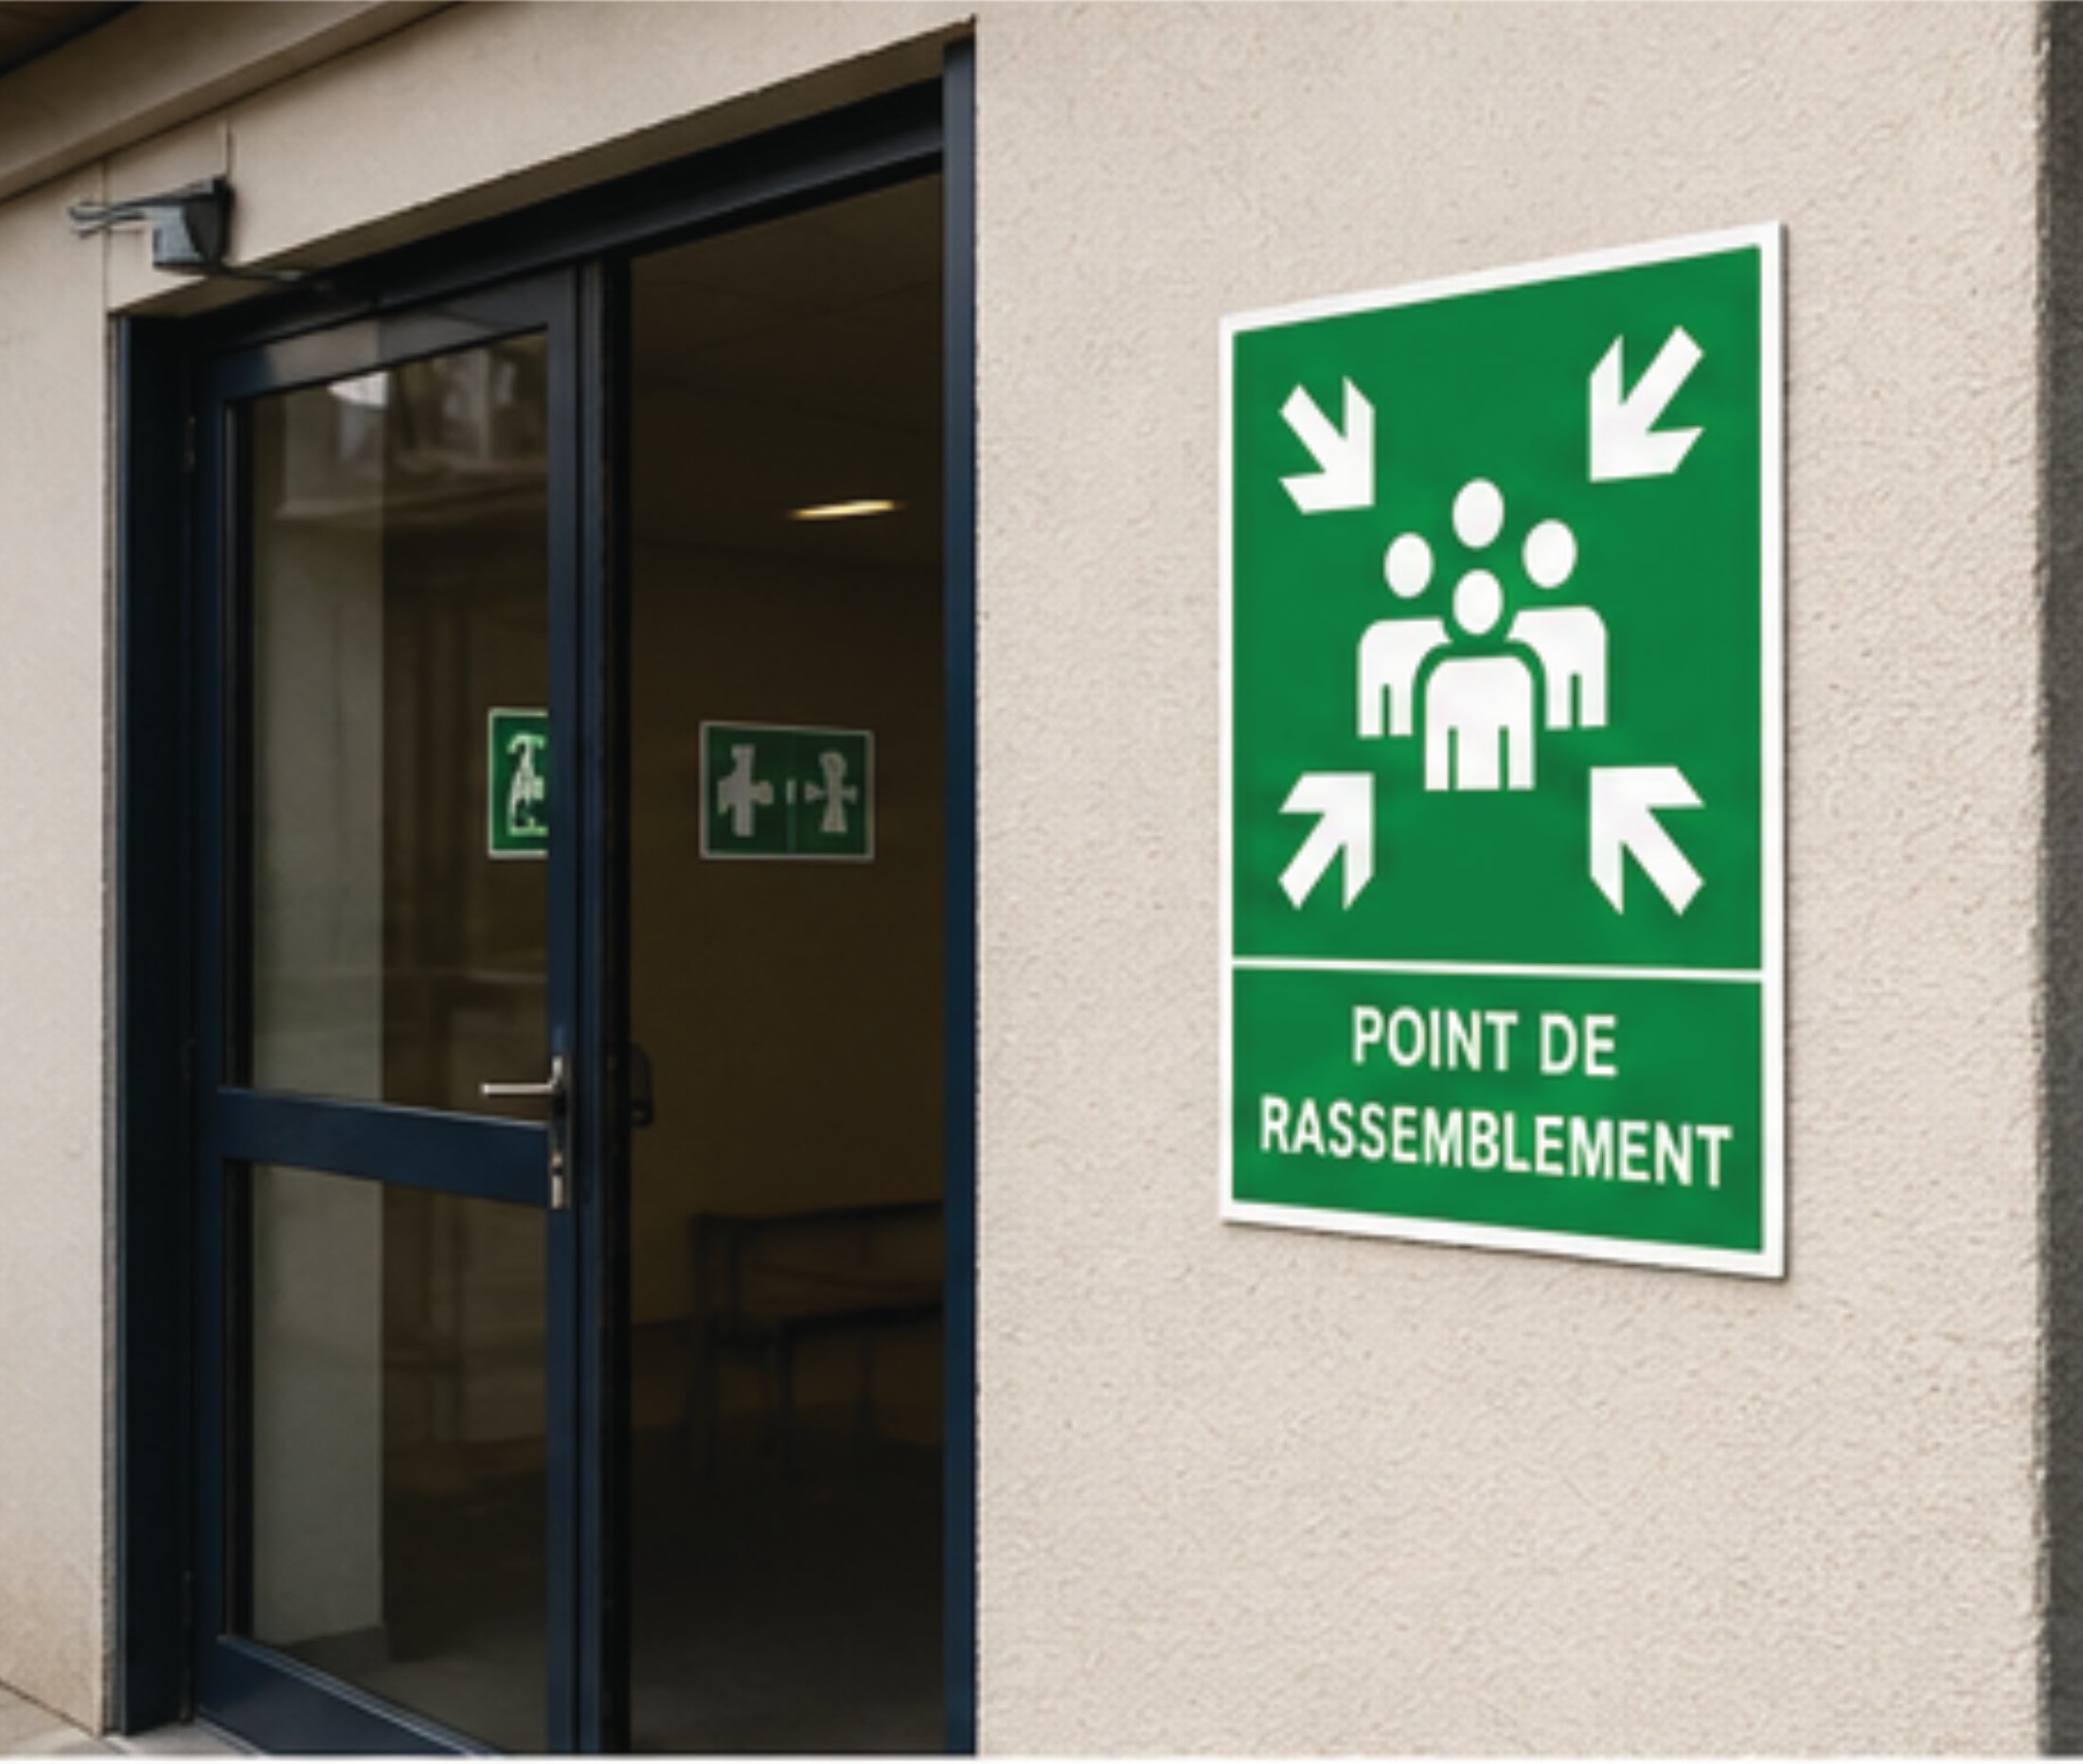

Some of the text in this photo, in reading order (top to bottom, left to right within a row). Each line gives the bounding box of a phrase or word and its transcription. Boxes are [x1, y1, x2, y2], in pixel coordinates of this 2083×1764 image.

[1352, 1005, 1618, 1078] POINT DE
[1260, 1095, 1733, 1188] RASSEMBLEMENT
